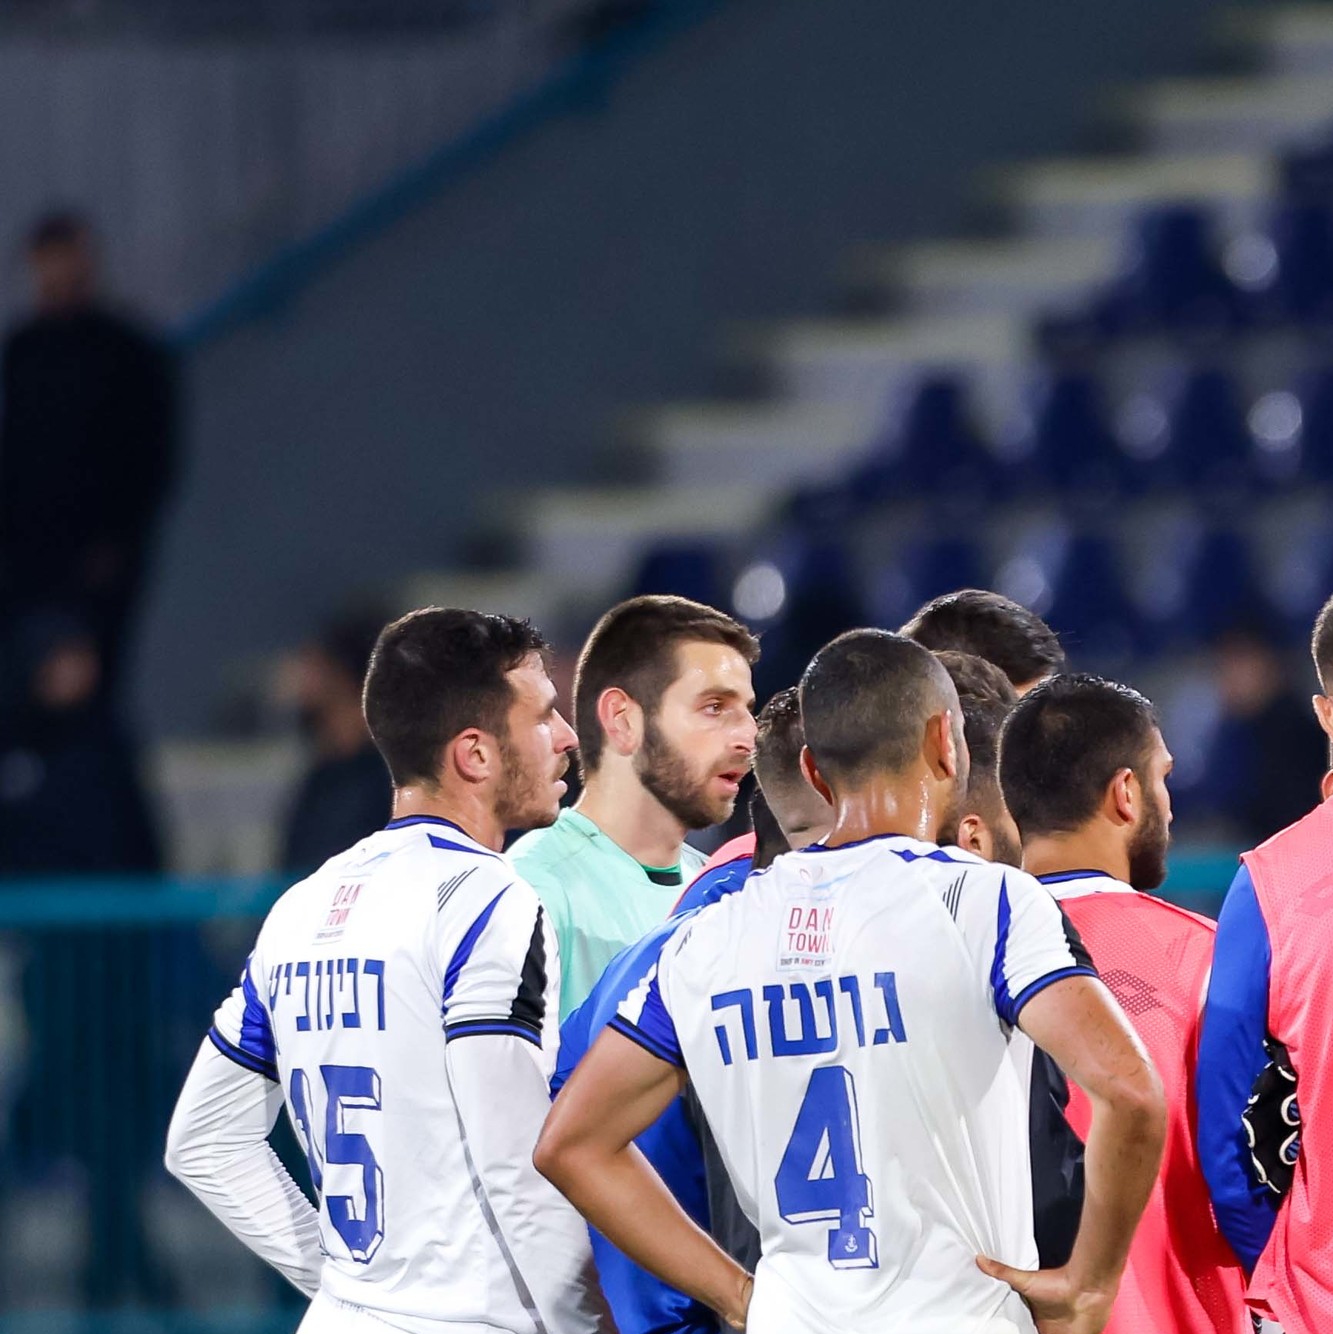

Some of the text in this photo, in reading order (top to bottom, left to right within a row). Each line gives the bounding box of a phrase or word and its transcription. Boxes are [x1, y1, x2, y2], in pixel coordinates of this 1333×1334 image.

[788, 906, 835, 932] DAN
[711, 970, 908, 1066] גושה
[773, 1065, 880, 1270] 4
